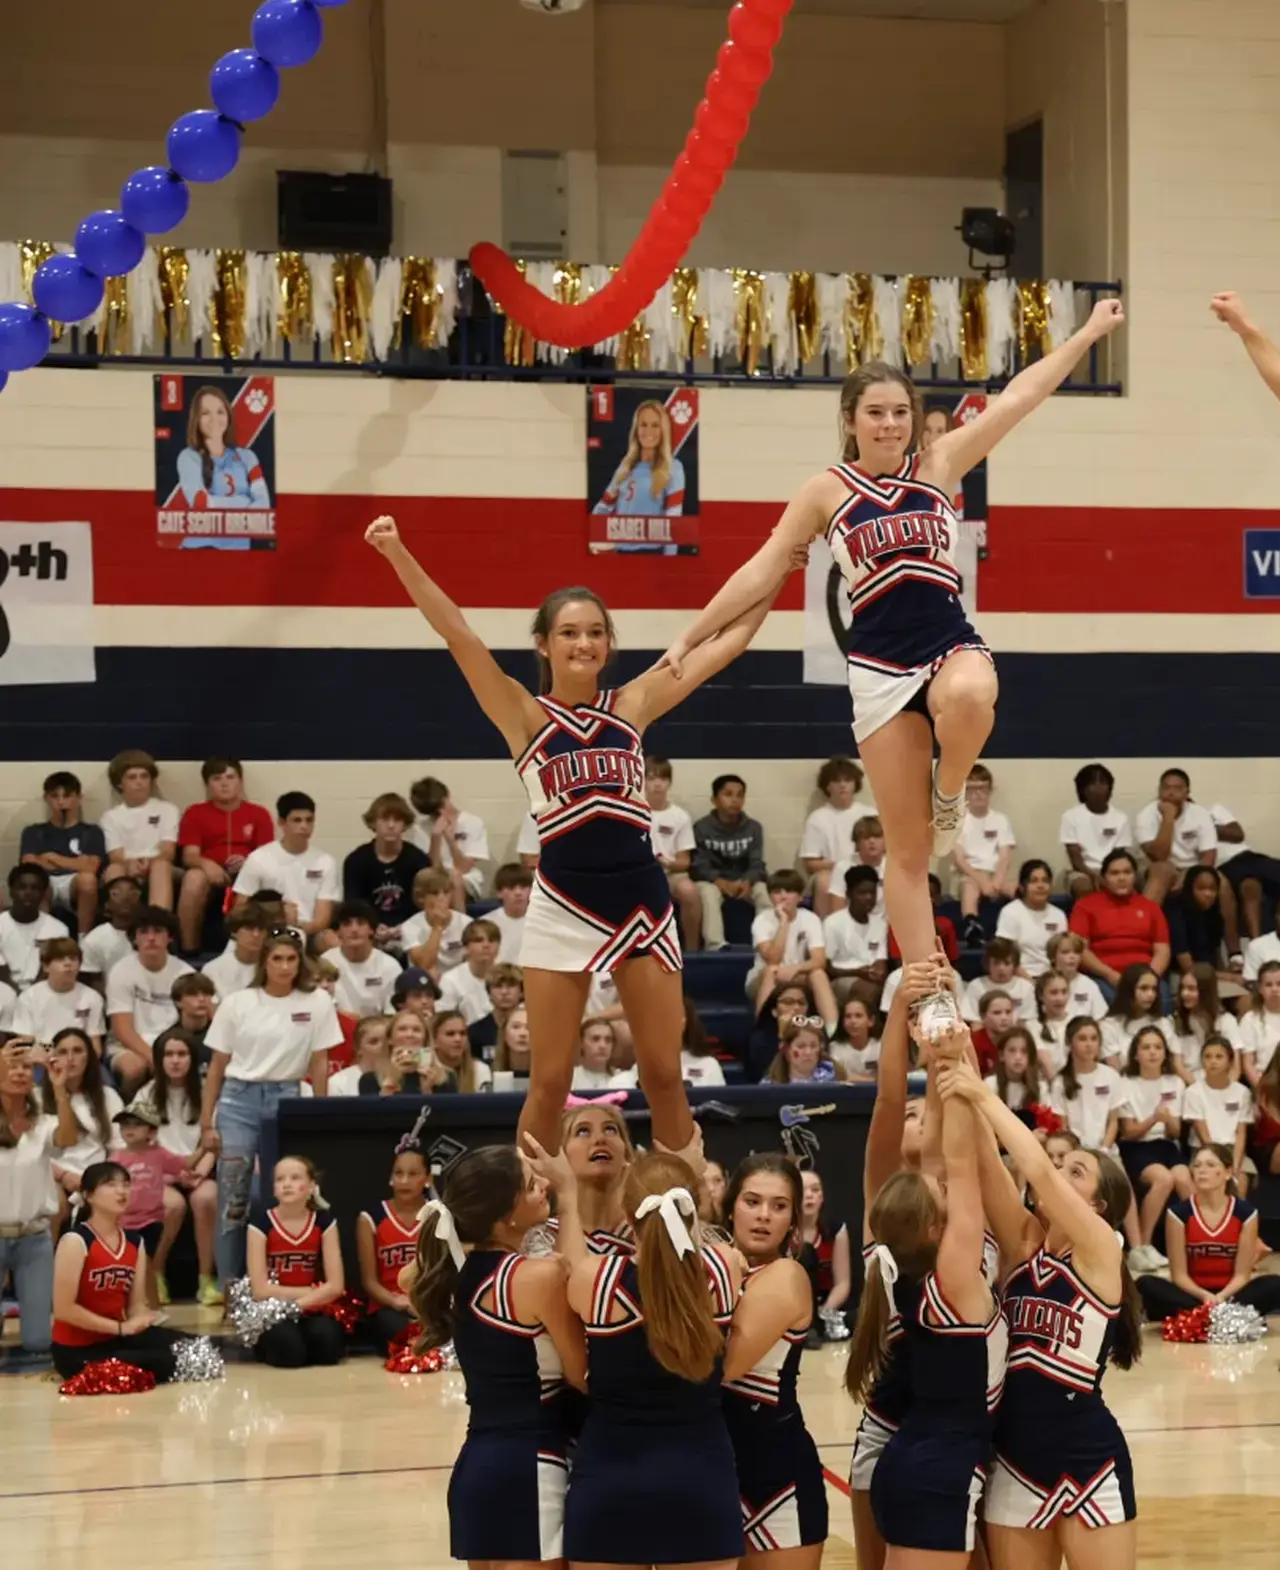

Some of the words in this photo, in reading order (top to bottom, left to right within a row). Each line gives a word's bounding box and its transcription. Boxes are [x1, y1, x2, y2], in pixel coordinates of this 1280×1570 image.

[186, 510, 223, 535] SCOTT
[843, 512, 951, 569] WILDCATS
[537, 749, 645, 804] WILDCATS
